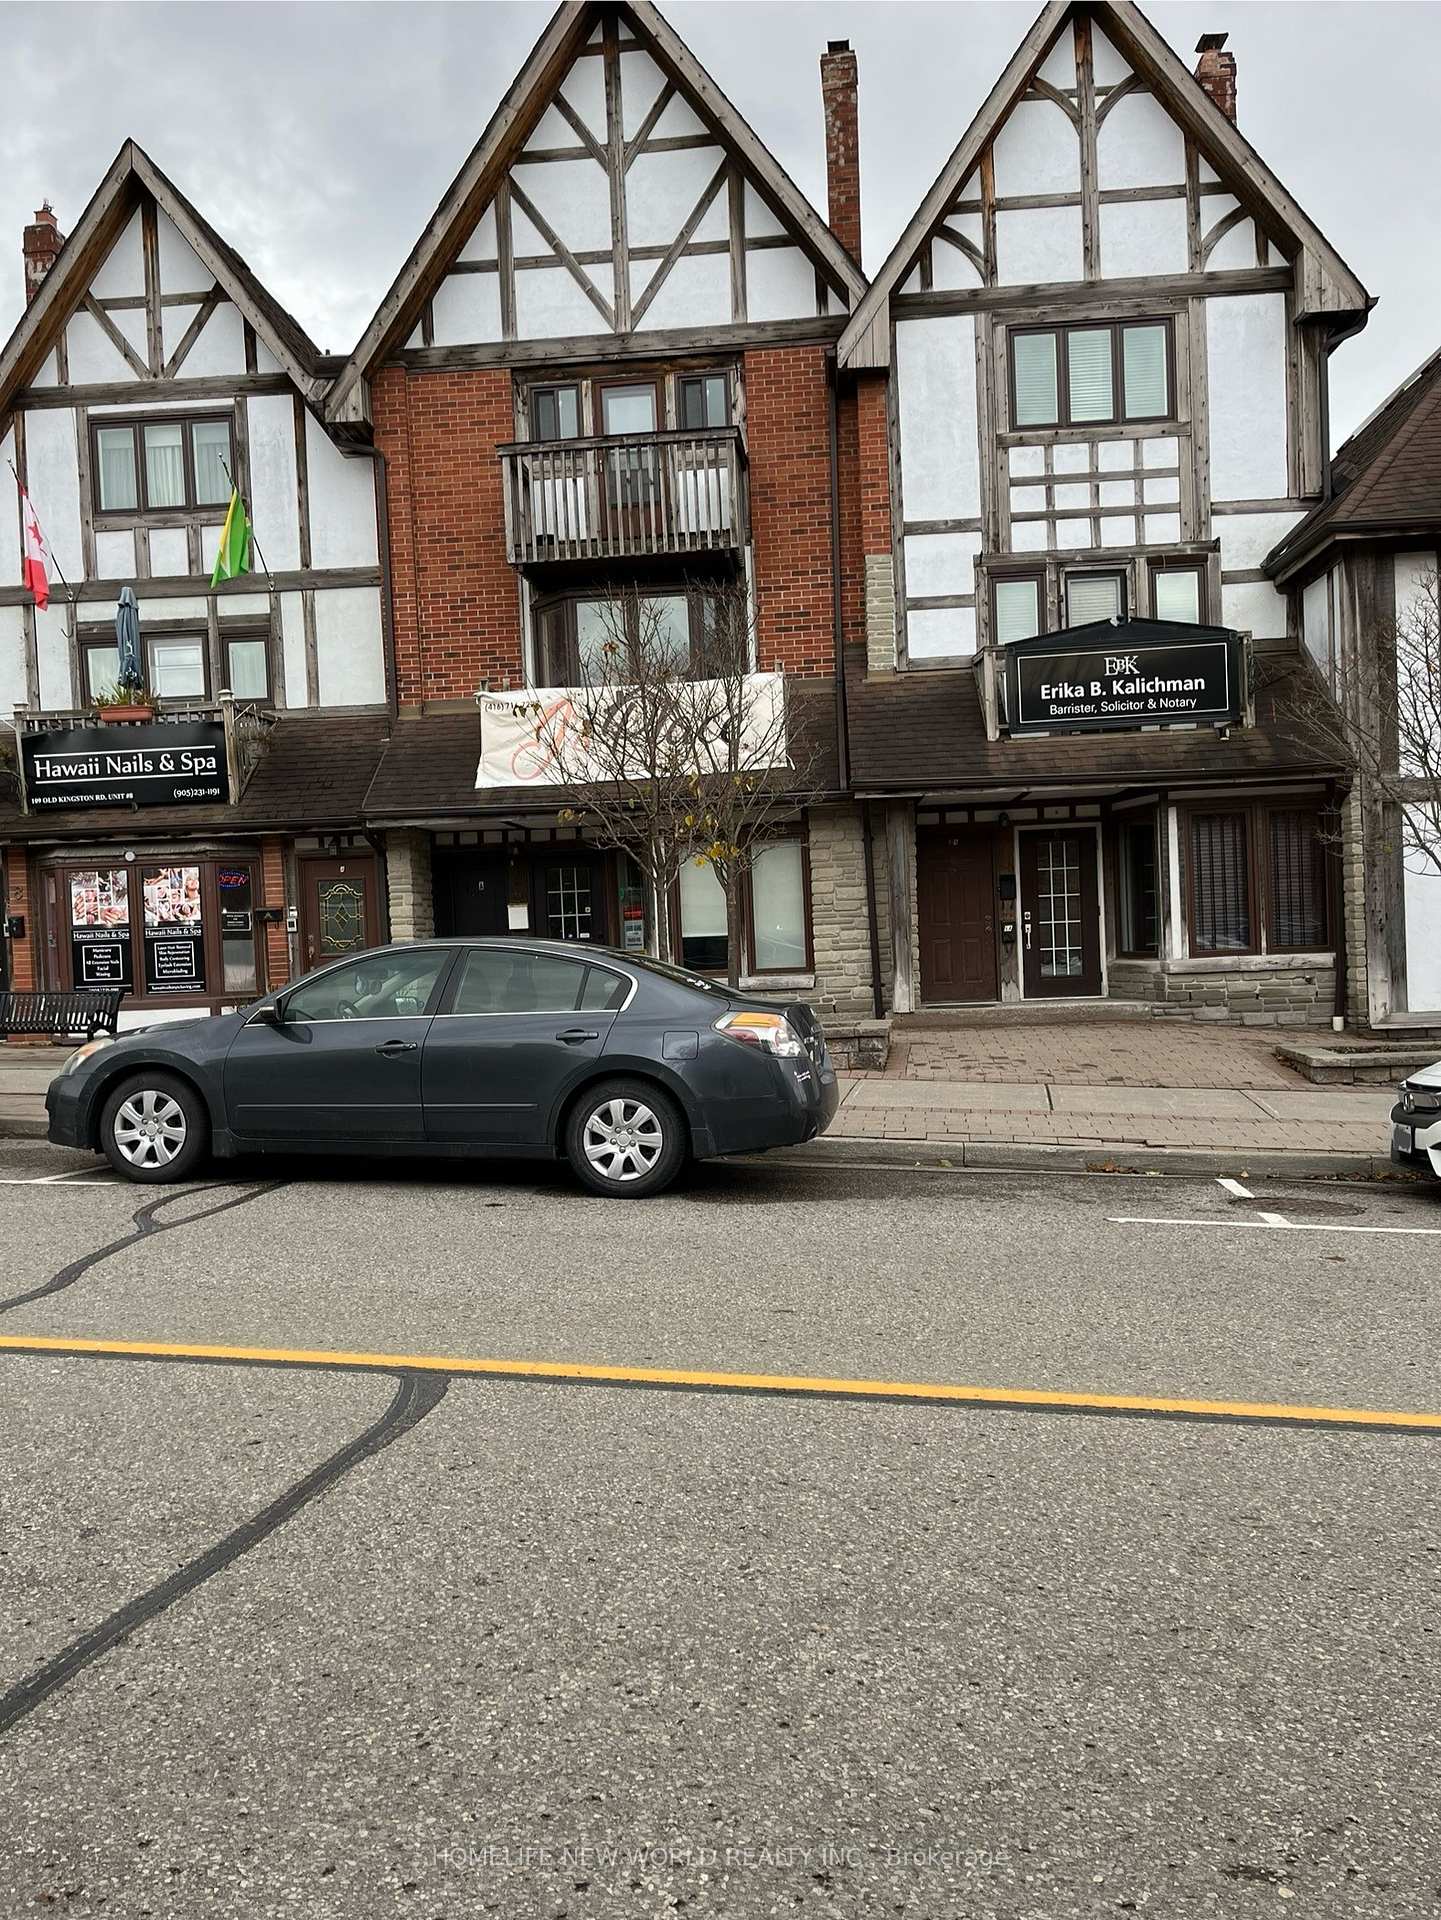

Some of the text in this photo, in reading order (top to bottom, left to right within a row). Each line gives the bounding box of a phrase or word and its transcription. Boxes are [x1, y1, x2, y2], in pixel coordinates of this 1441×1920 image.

[1040, 676, 1206, 700] Erika B. Kalichman
[1050, 697, 1197, 716] Barrister, Solicitor & Notary
[34, 752, 217, 778] Hawaii Nails & Spa
[42, 796, 58, 804] OLD
[58, 794, 94, 804] KINGSTON
[108, 792, 125, 801] UNIT
[173, 787, 221, 799] (905)231-1191
[218, 875, 247, 885] OPEN
[95, 930, 110, 938] Nails
